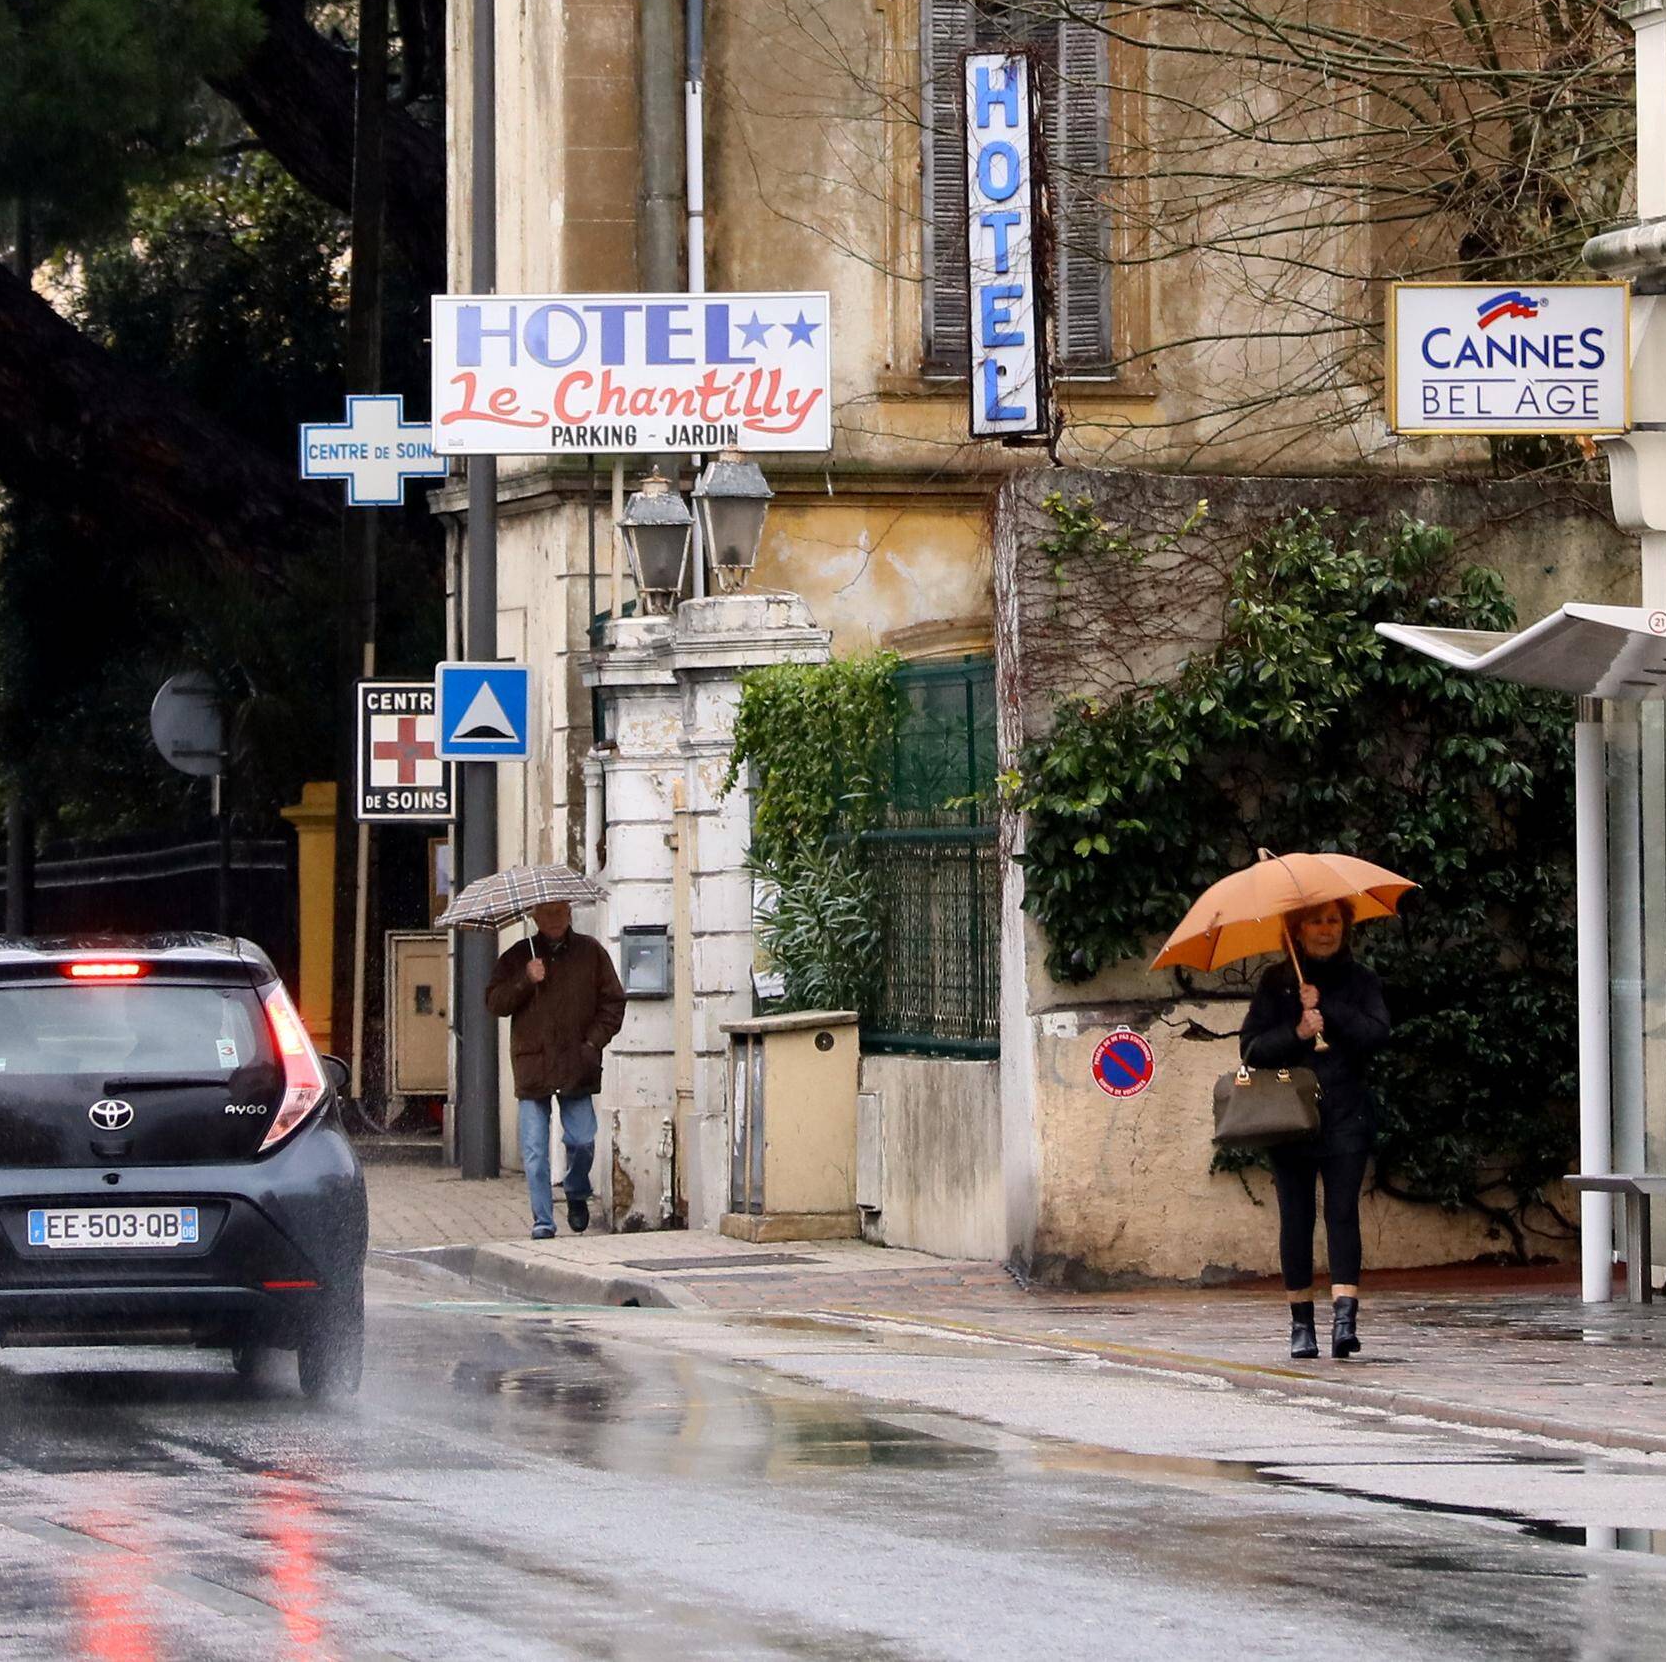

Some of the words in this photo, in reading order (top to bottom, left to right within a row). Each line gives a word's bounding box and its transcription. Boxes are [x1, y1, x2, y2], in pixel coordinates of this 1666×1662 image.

[975, 66, 1026, 421] HOTEL
[456, 303, 757, 368] HOTEL
[1421, 327, 1606, 370] CANNES
[440, 370, 550, 429] Le
[552, 367, 825, 434] Chantilly
[1422, 384, 1493, 415] BEL
[550, 424, 638, 448] PARKING
[664, 423, 739, 447] JARDIN
[308, 443, 368, 460] CENTRE
[374, 446, 390, 459] DE
[396, 442, 433, 459] SOIN
[1654, 617, 1665, 627] 21
[367, 692, 433, 711] CENTR
[365, 794, 382, 809] DE
[386, 791, 448, 810] SOINS
[224, 1104, 268, 1116] AYGO
